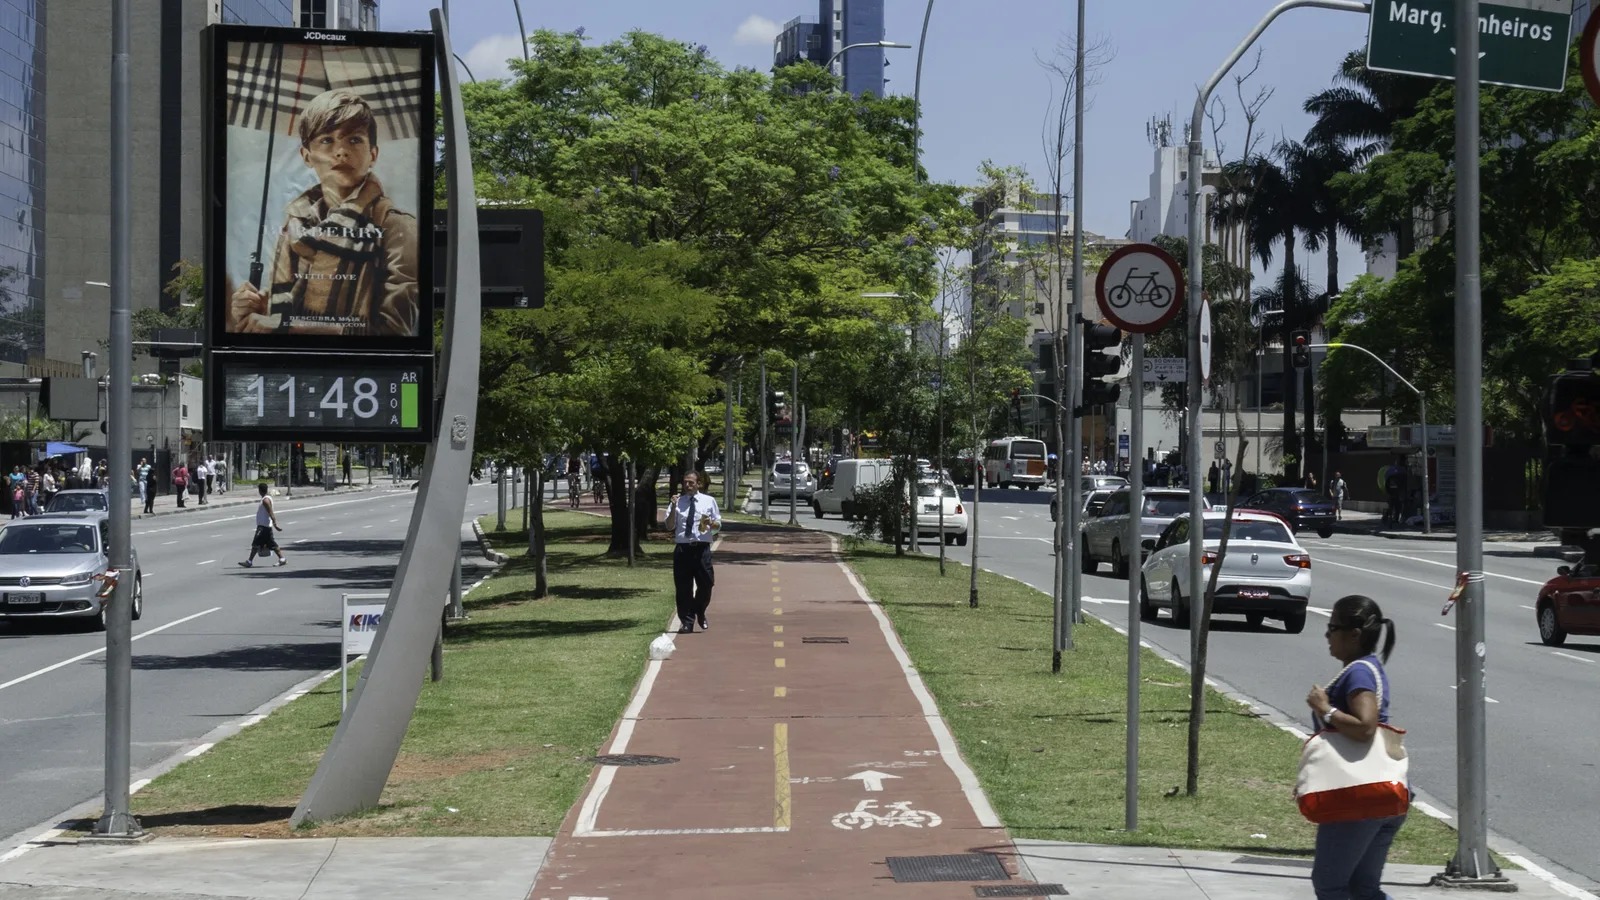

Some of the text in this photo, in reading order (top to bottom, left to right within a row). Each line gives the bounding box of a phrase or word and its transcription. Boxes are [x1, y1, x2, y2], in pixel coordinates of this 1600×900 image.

[1389, 1, 1553, 42] Marg. nheiros
[303, 31, 347, 41] JCDecaux
[329, 273, 357, 281] LOVE
[401, 372, 418, 383] AR
[247, 375, 379, 419] 11:48
[350, 614, 382, 626] KIK
